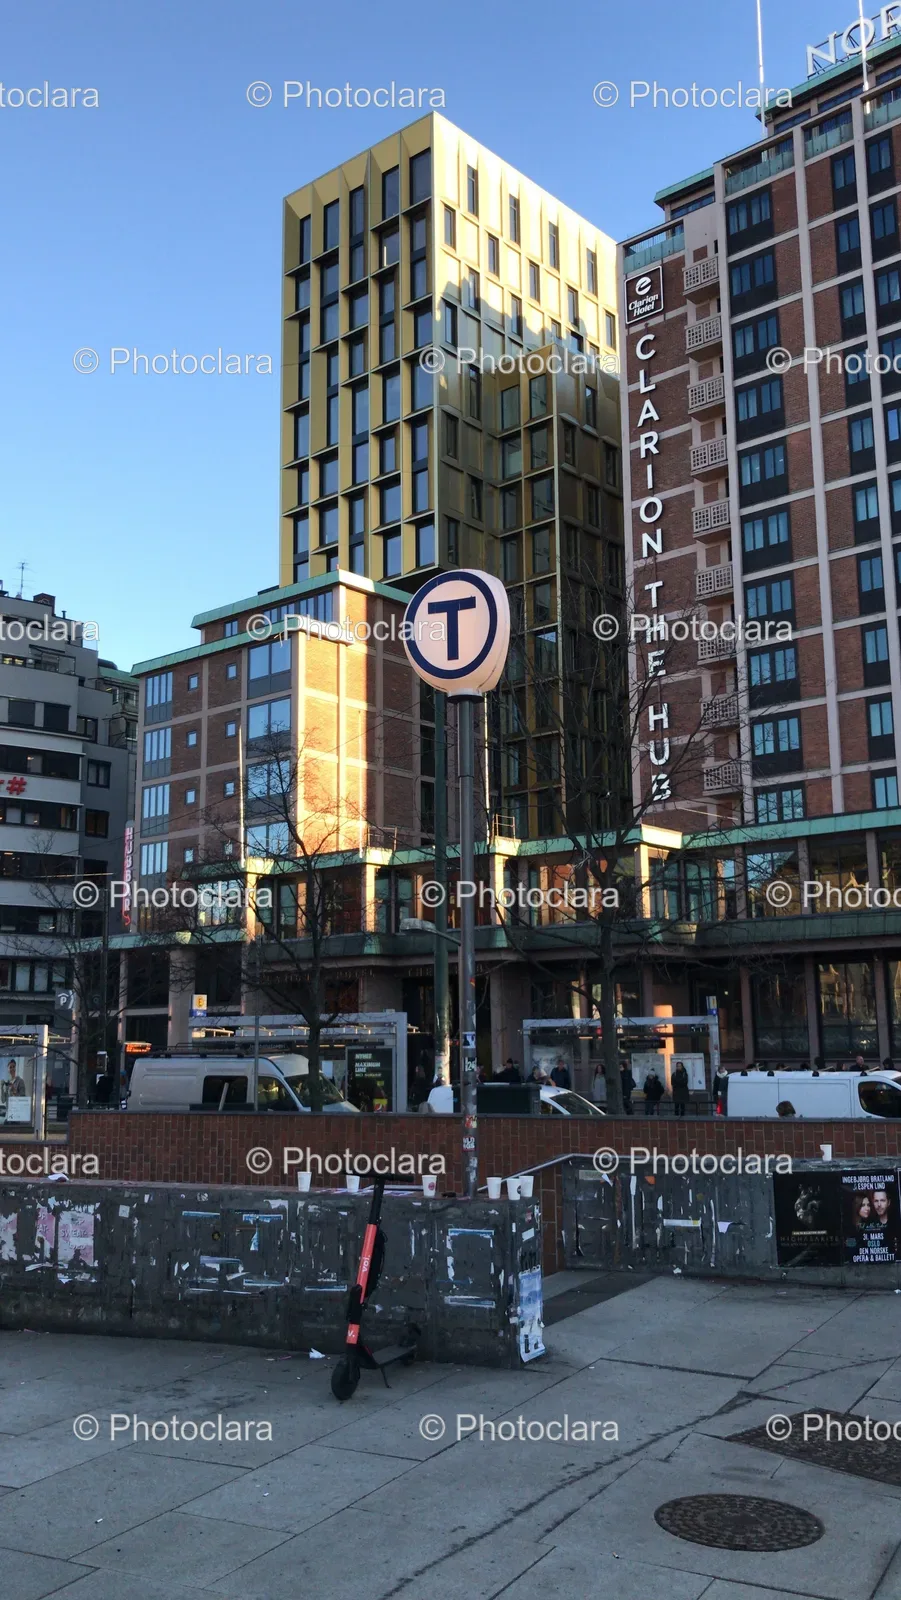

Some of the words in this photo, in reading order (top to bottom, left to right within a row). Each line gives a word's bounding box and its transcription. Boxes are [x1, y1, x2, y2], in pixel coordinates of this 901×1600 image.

[629, 294, 659, 310] Clarion
[633, 301, 655, 316] Hotel
[634, 333, 664, 558] CLARION
[427, 595, 477, 661] T
